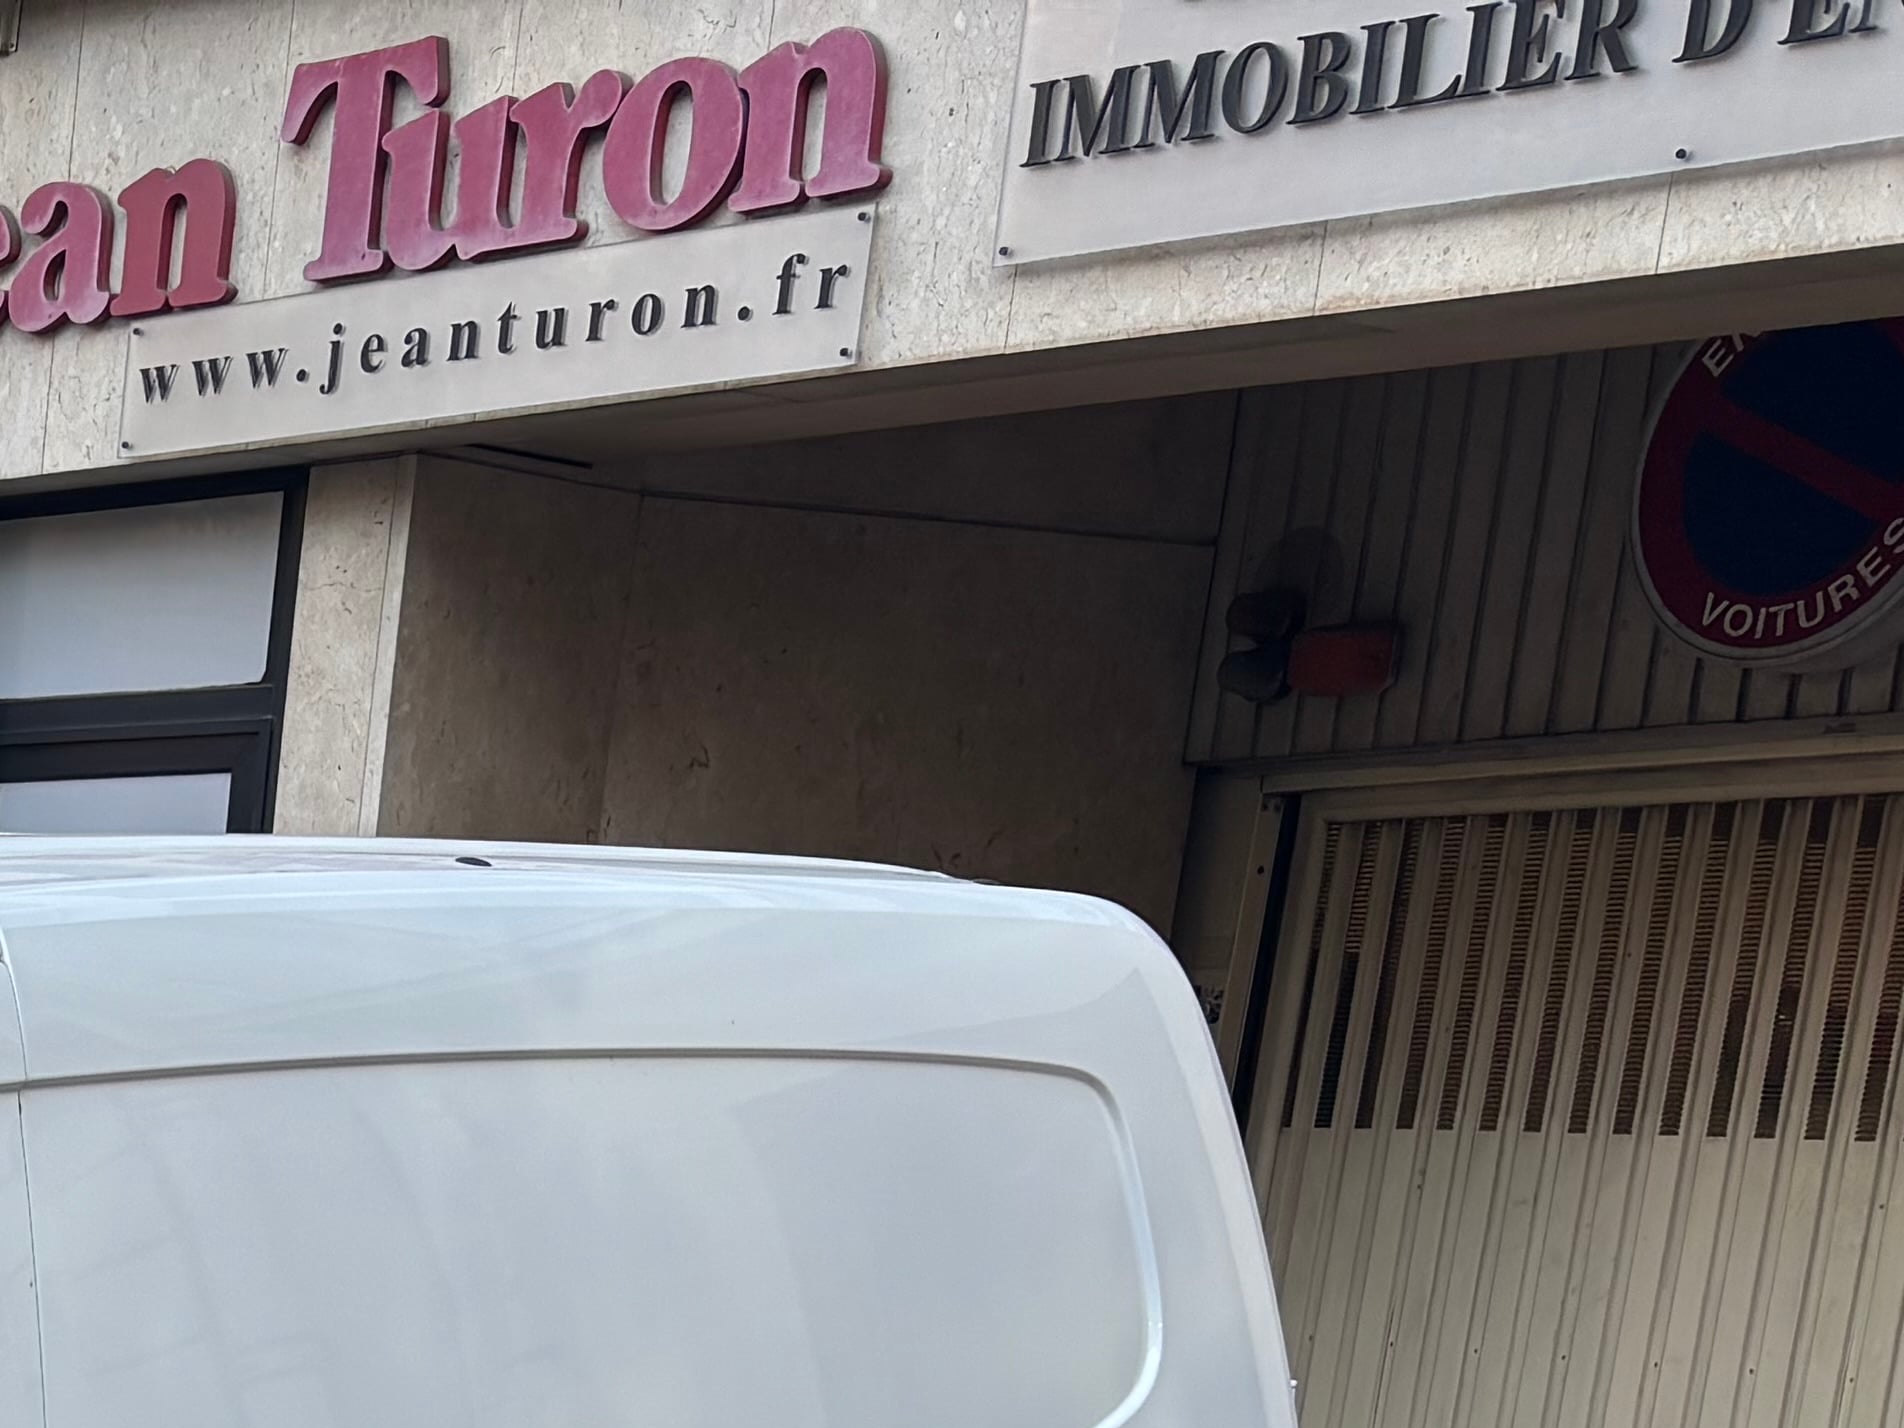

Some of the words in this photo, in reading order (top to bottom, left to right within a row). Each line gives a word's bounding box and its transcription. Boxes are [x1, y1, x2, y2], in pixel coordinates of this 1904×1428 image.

[281, 26, 893, 285] Turon
[1018, 0, 1638, 169] IMMOBILIER
[137, 250, 852, 407] www.jeanturon.fr
